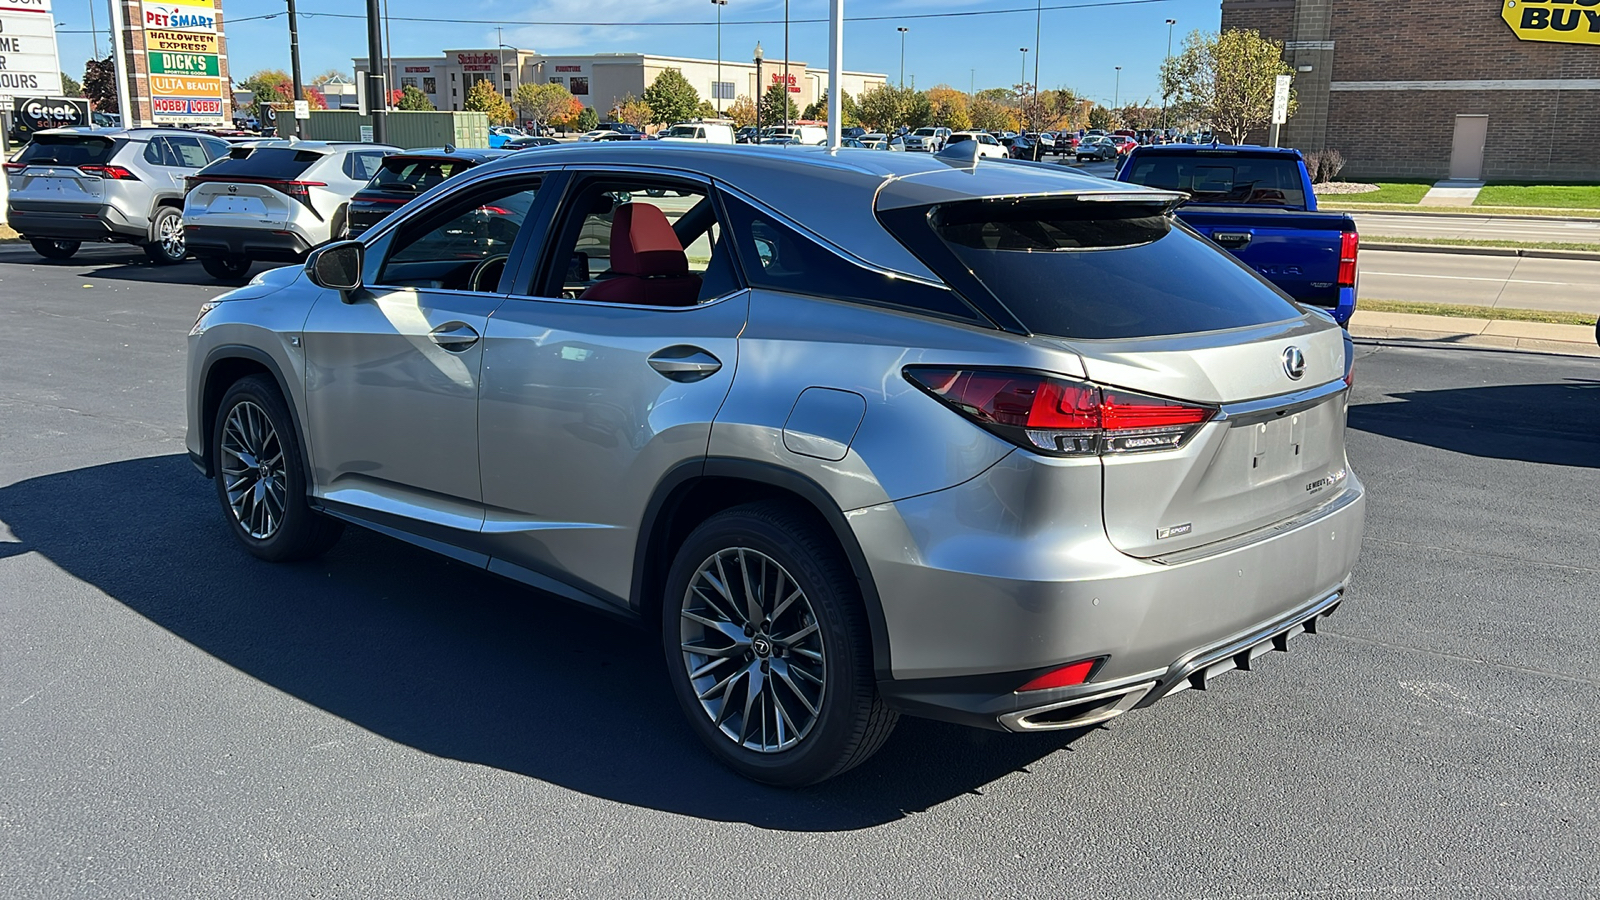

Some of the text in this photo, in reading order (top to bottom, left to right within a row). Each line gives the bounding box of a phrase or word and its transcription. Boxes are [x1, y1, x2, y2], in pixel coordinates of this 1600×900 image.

[1520, 8, 1600, 32] BUY
[150, 32, 214, 42] HALLOWEEN
[159, 42, 207, 51] EXPRESS
[162, 53, 207, 70] DICK'S
[0, 74, 38, 88] OURS
[155, 78, 219, 91] ULTA BEAUTY
[27, 102, 77, 121] Geek
[154, 98, 220, 113] HOBBY LOBBY
